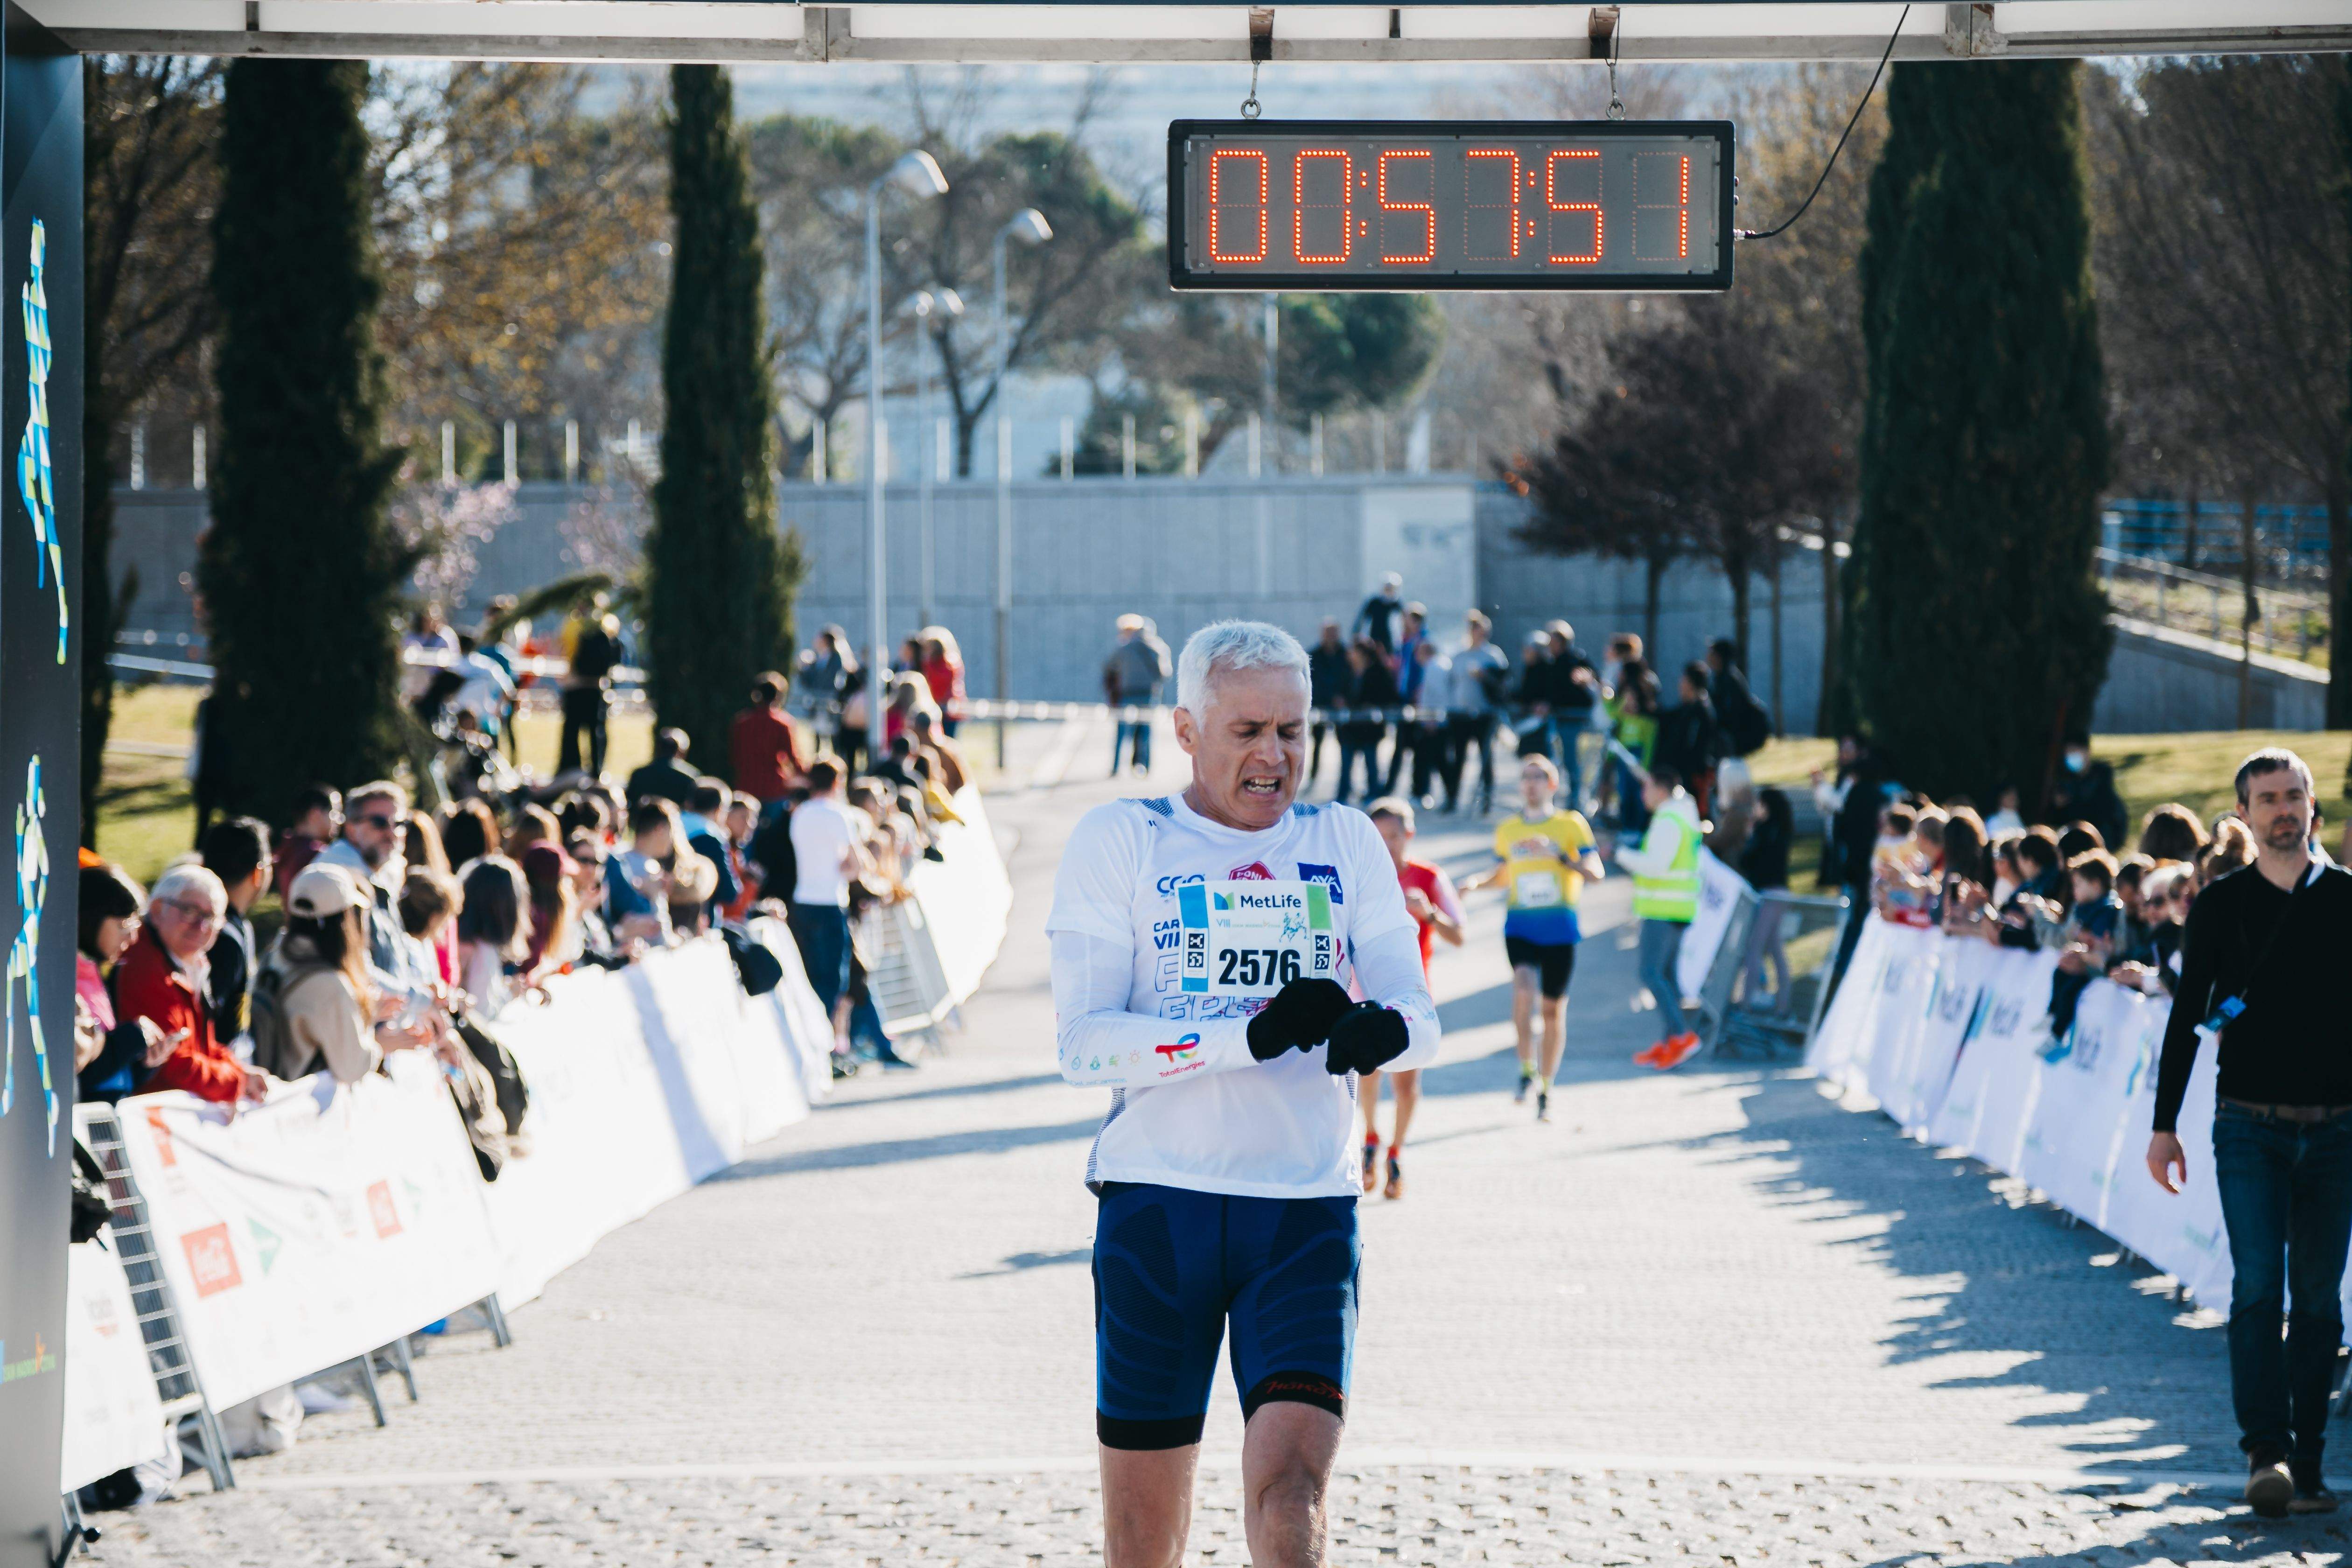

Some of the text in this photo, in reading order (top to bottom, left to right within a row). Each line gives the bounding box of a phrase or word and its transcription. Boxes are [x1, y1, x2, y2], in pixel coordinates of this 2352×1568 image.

[1211, 149, 1690, 264] 00:57:51
[1240, 894, 1302, 908] MetLife
[1216, 918, 1231, 928] VIII
[1218, 948, 1301, 986] 2576
[1158, 1060, 1205, 1078] TotalEnergies
